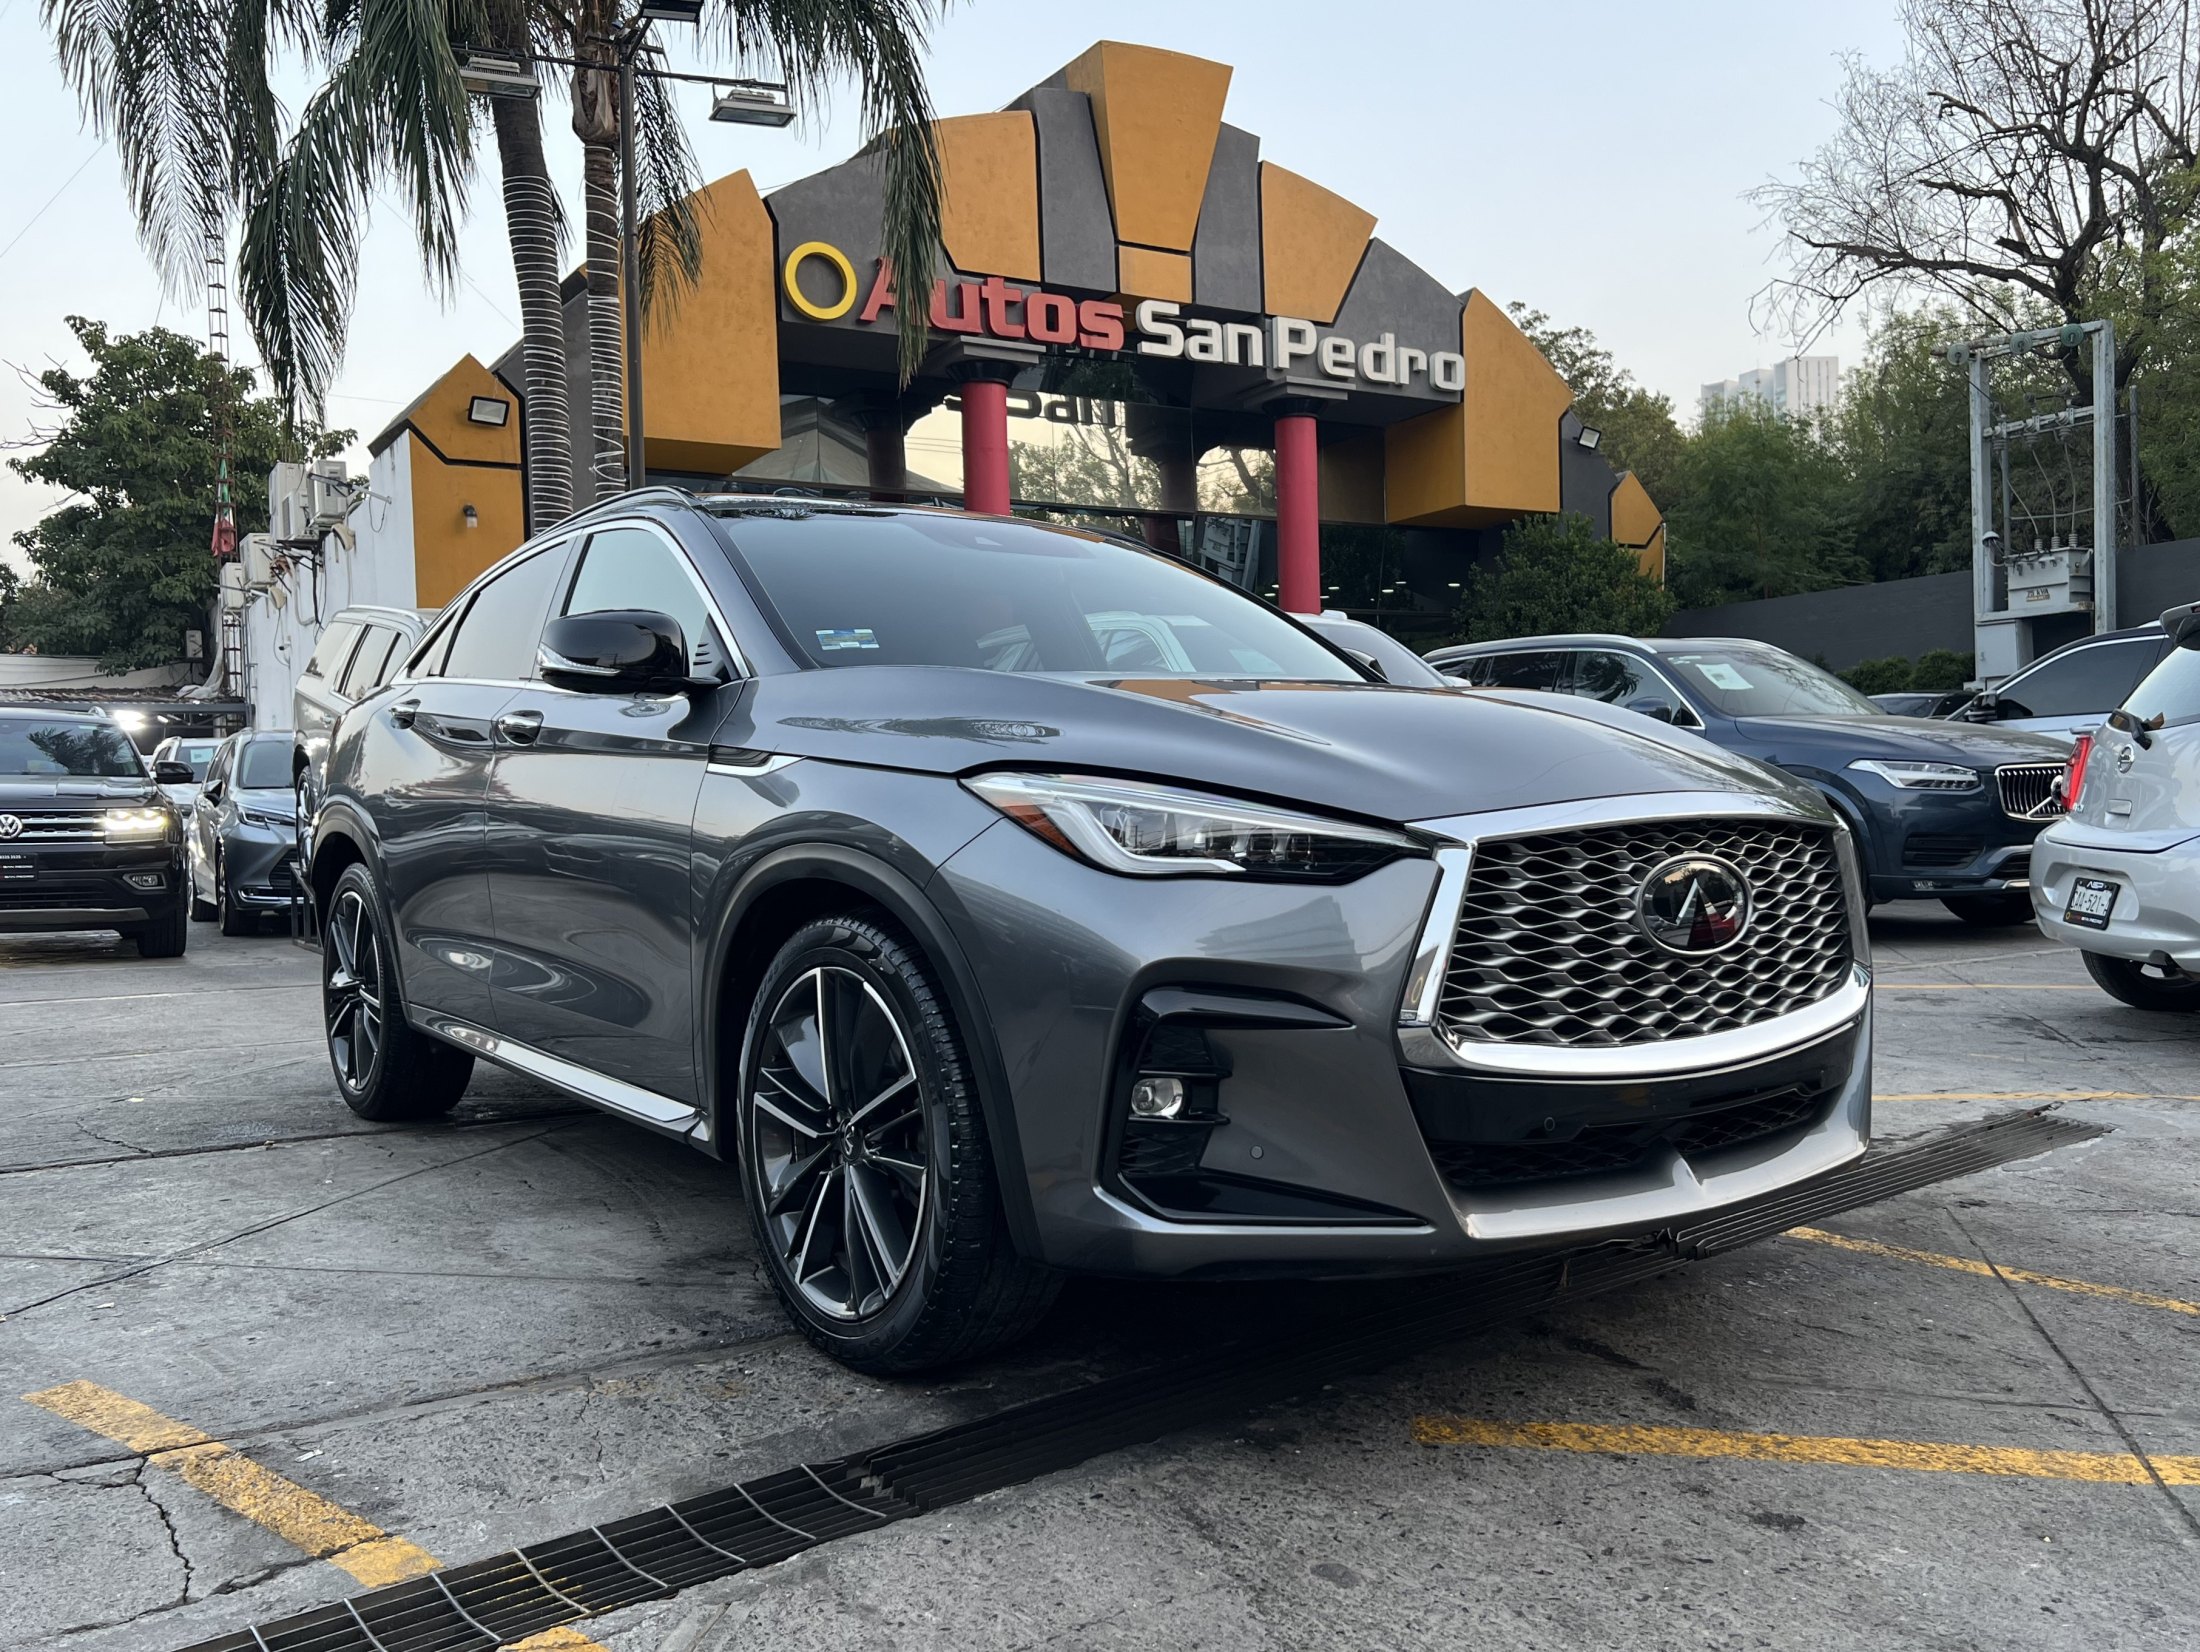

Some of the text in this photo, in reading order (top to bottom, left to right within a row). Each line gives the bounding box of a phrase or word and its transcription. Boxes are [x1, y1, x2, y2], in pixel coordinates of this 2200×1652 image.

[859, 255, 1466, 392] Autos San Pedro
